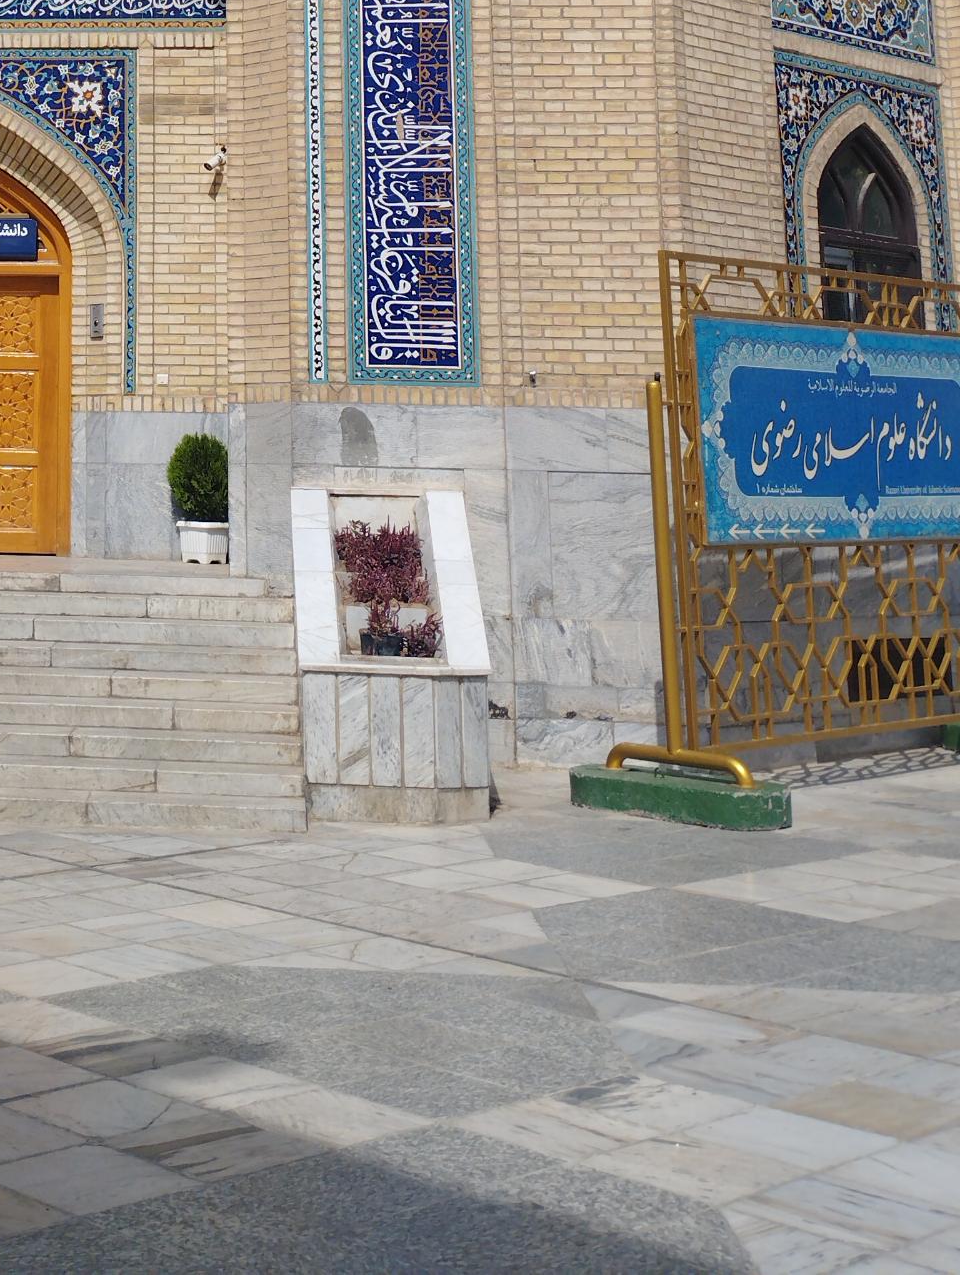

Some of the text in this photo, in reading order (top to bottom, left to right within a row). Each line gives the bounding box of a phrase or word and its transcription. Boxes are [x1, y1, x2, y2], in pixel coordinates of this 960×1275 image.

[751, 391, 952, 492] دانشگاه علوم اسلامی رضوی
